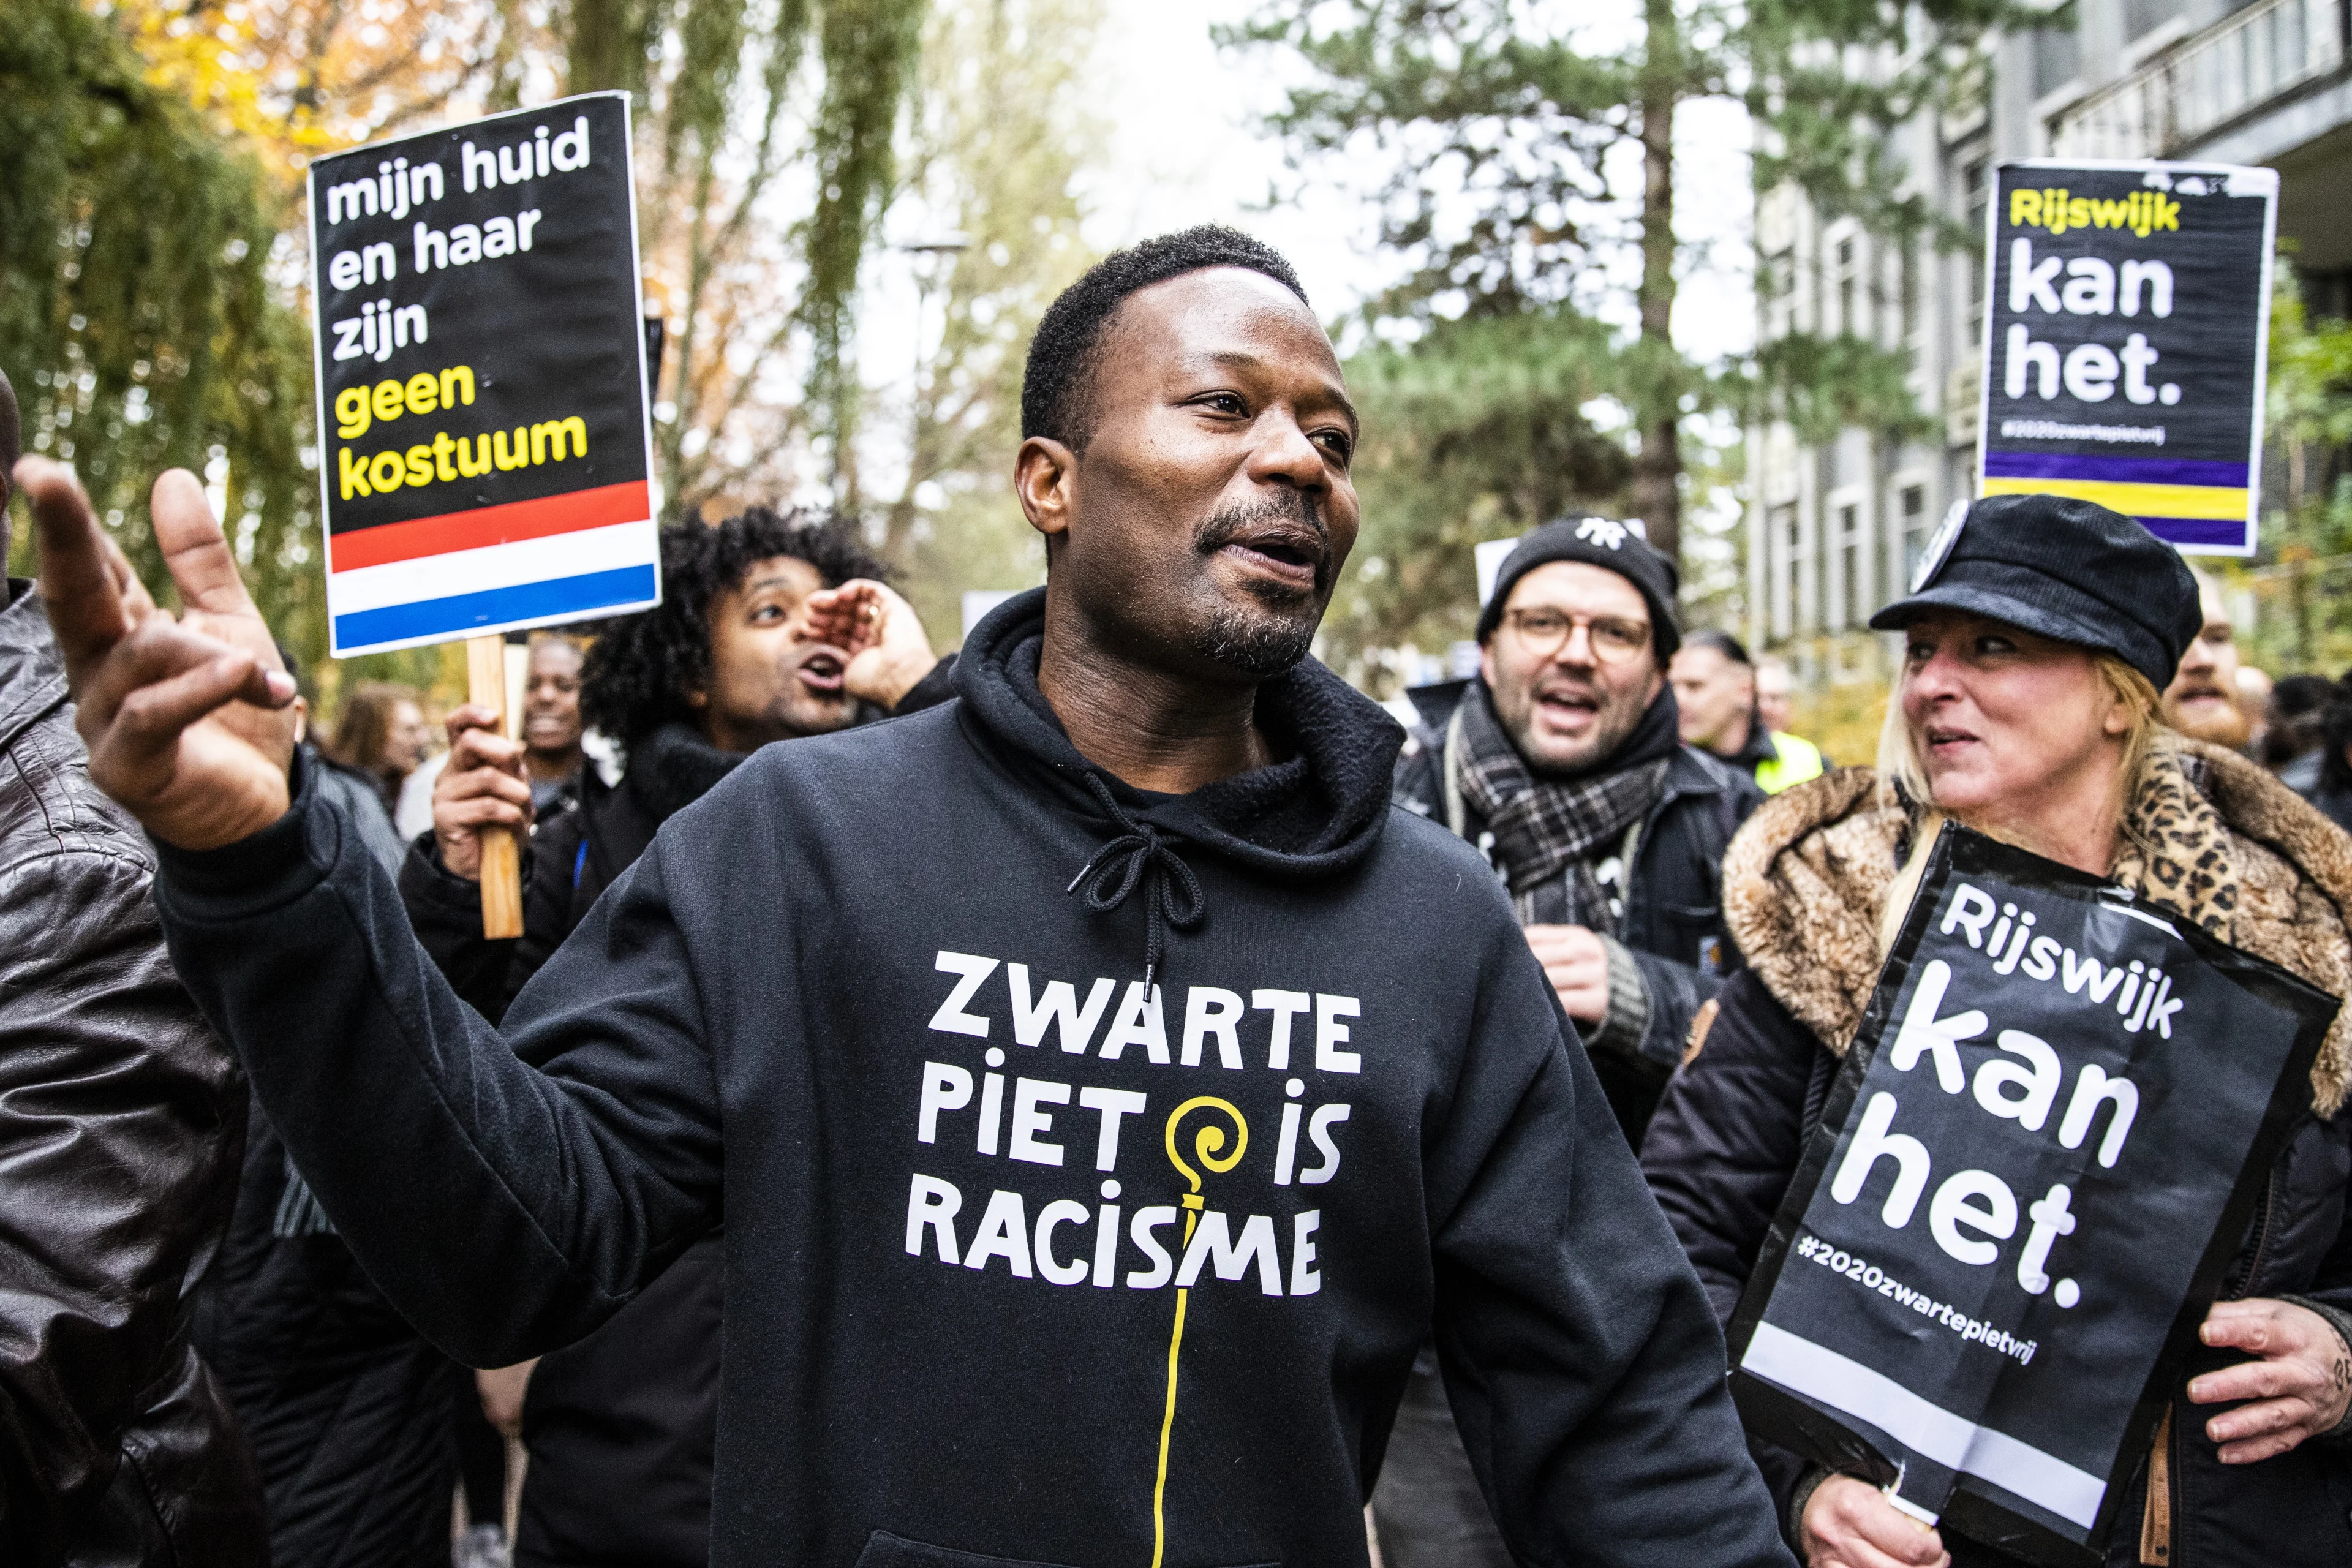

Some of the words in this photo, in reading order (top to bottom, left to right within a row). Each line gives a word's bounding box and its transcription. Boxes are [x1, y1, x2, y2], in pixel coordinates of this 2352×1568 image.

[327, 157, 444, 225] mijn
[462, 116, 590, 193] huid
[329, 242, 396, 291] en
[413, 209, 541, 273] haar
[2010, 189, 2180, 236] Rijswijk
[2008, 237, 2174, 318] kan
[332, 298, 428, 362] zijn
[2004, 323, 2181, 405] het.
[335, 366, 475, 439] geen
[339, 417, 587, 500] kostuum
[1942, 883, 2184, 1039] Rijswijk
[928, 951, 1361, 1074] ZWARTE
[1890, 959, 2139, 1168] kan
[1831, 1091, 2081, 1306] het.
[1798, 1236, 2037, 1365] #2020zwartepietvrij
